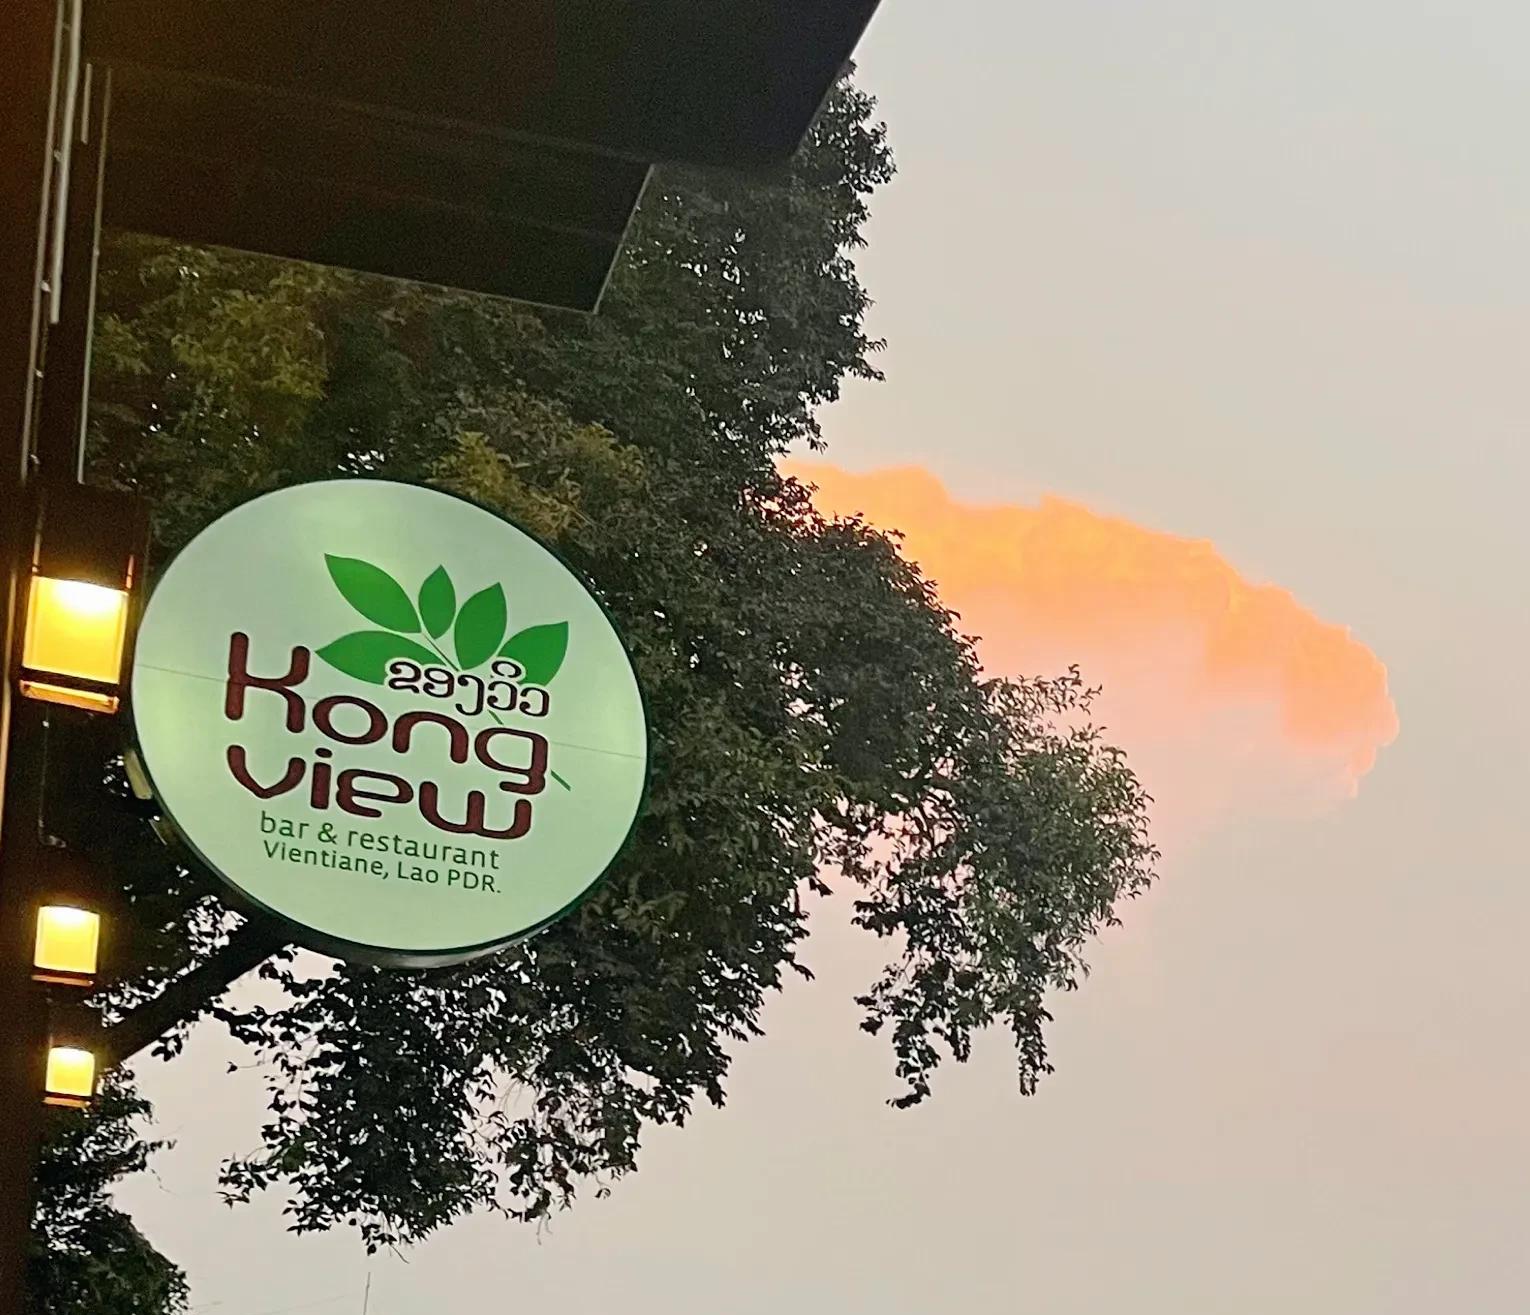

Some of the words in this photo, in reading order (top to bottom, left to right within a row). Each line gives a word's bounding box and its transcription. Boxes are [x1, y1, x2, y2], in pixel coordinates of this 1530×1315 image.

[224, 631, 550, 795] Kong
[226, 745, 532, 840] view
[260, 811, 310, 839] bar
[317, 822, 338, 844] &
[348, 829, 500, 869] restaurant
[263, 840, 390, 880] Vientiane,
[397, 861, 439, 883] Lao
[447, 868, 502, 893] PDR.
